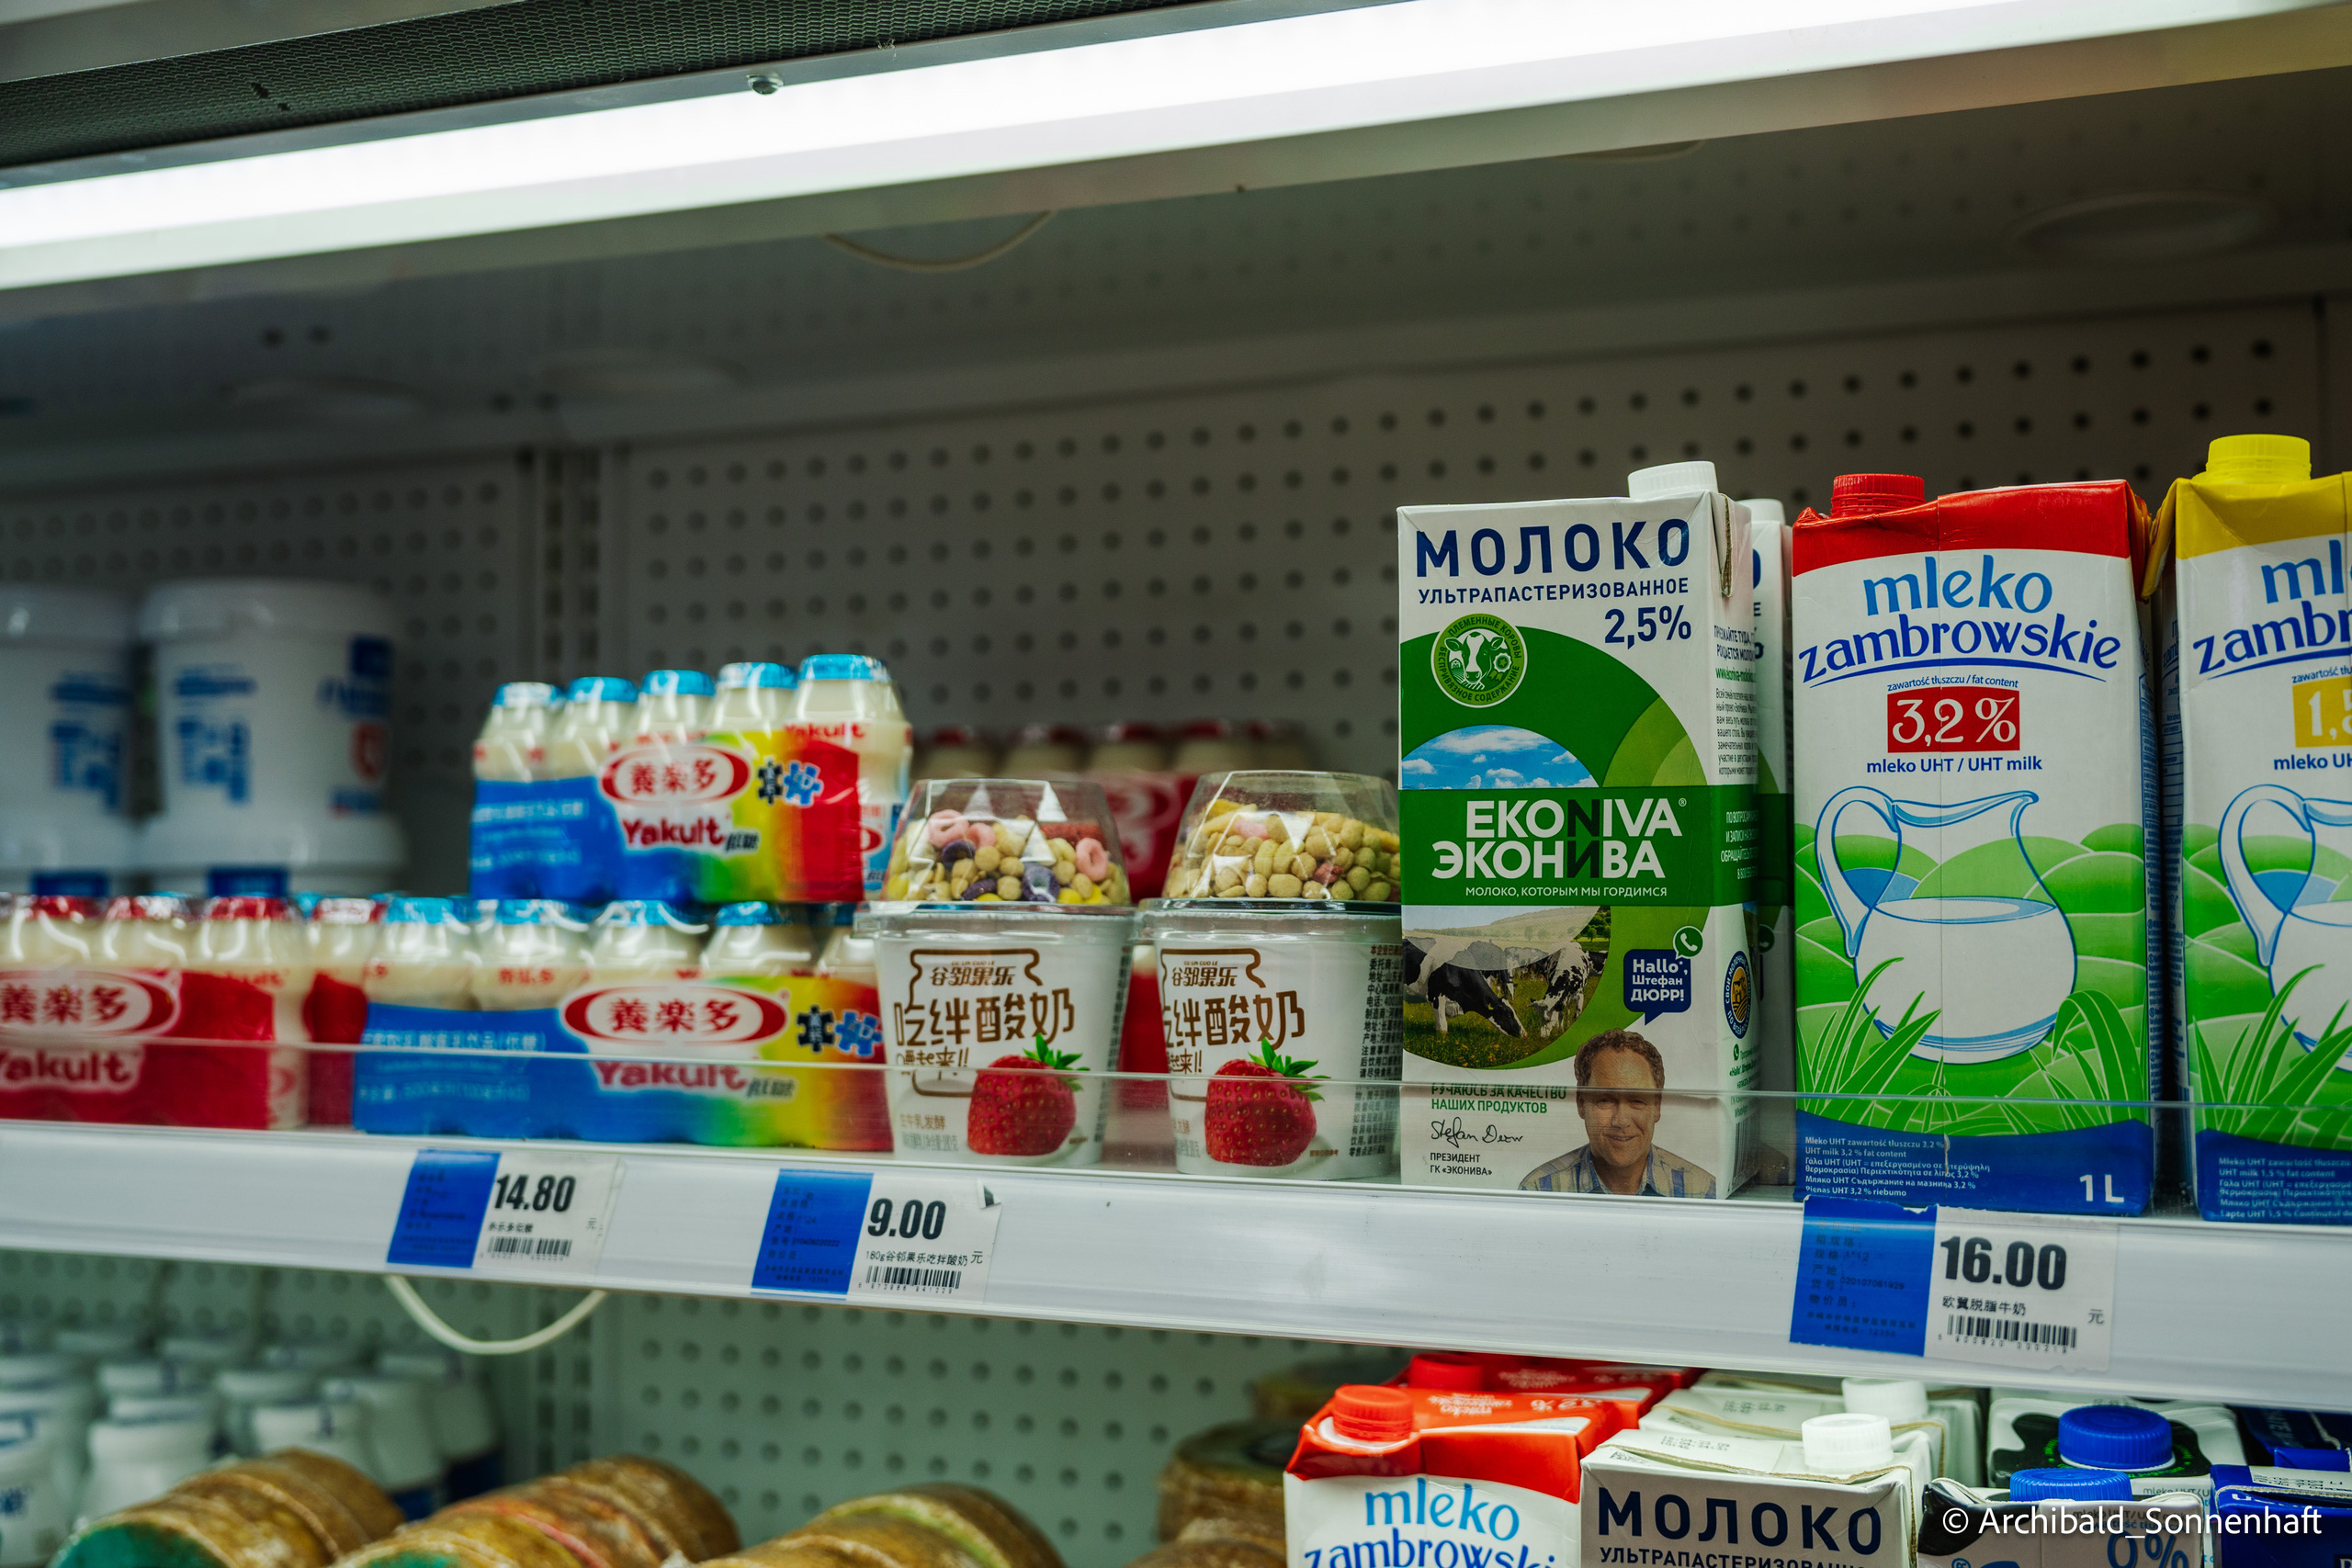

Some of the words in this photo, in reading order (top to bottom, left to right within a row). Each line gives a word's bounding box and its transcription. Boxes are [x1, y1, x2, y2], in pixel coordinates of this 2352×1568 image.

[1417, 519, 1690, 577] МОЛОКО
[1863, 555, 2053, 615] mleko
[2261, 539, 2352, 604] ml
[1419, 577, 1689, 604] УЛЬТРАПАСТЕРИЗОВАННОЕ
[1448, 616, 1500, 636] ПЛЕМЕННЫЕ
[1500, 625, 1521, 659] КОРОВЫ
[1604, 604, 1691, 650] 2,5%
[1798, 613, 2120, 684] zambrowskie
[1439, 647, 1473, 701] БЕСПРИВЯЗНОЕ
[1475, 666, 1520, 702] СОДЕРЖАНИЕ
[1887, 676, 1930, 692] zawartość
[1931, 675, 1965, 684] tłuszczu
[1973, 674, 1984, 684] fat
[1984, 677, 2019, 688] content
[1893, 698, 1964, 747] 3,2
[1975, 697, 2017, 743] %
[1867, 759, 1917, 773] mleko
[1920, 758, 1954, 773] UHT
[1957, 758, 1964, 773] /
[1968, 757, 2003, 772] UHT
[2007, 756, 2042, 771] milk
[2274, 753, 2328, 771] mleko
[622, 817, 725, 846] Yakult
[1431, 840, 1666, 879] ЭКОНИВА
[1465, 887, 1520, 899] МОЛОКО,
[1521, 886, 1578, 897] КОТОРЫМ
[1580, 886, 1600, 897] МЫ
[1603, 886, 1668, 897] ГОРДИМСЯ
[1630, 988, 1685, 1002] ДЮРР!
[1632, 975, 1683, 988] Штефан
[593, 1059, 747, 1091] Yakult
[1431, 1099, 1476, 1111] НАШИХ
[1477, 1100, 1548, 1114] ПРОДУКТОВ
[1805, 1136, 1828, 1145] Mleko
[1828, 1137, 1846, 1145] UHT
[1847, 1138, 1887, 1147] zawartość
[1822, 1147, 1839, 1156] milk
[1863, 1148, 1875, 1156] fat
[1876, 1149, 1906, 1157] content
[1430, 1152, 1481, 1163] ПРЕЗИДЕНТ
[1430, 1165, 1441, 1174] ГК
[1442, 1166, 1493, 1176] «ЭКОНИВА»
[1842, 1158, 1862, 1168] (UHT
[494, 1174, 577, 1213] 14.80
[1872, 1188, 1906, 1197] riebumo
[867, 1198, 946, 1240] 9.00
[971, 1250, 983, 1264] 元
[1939, 1235, 2067, 1291] 16.00
[2087, 1308, 2105, 1325] 元
[1365, 1478, 1520, 1541] mleko
[1599, 1487, 1882, 1555] МОЛОКО
